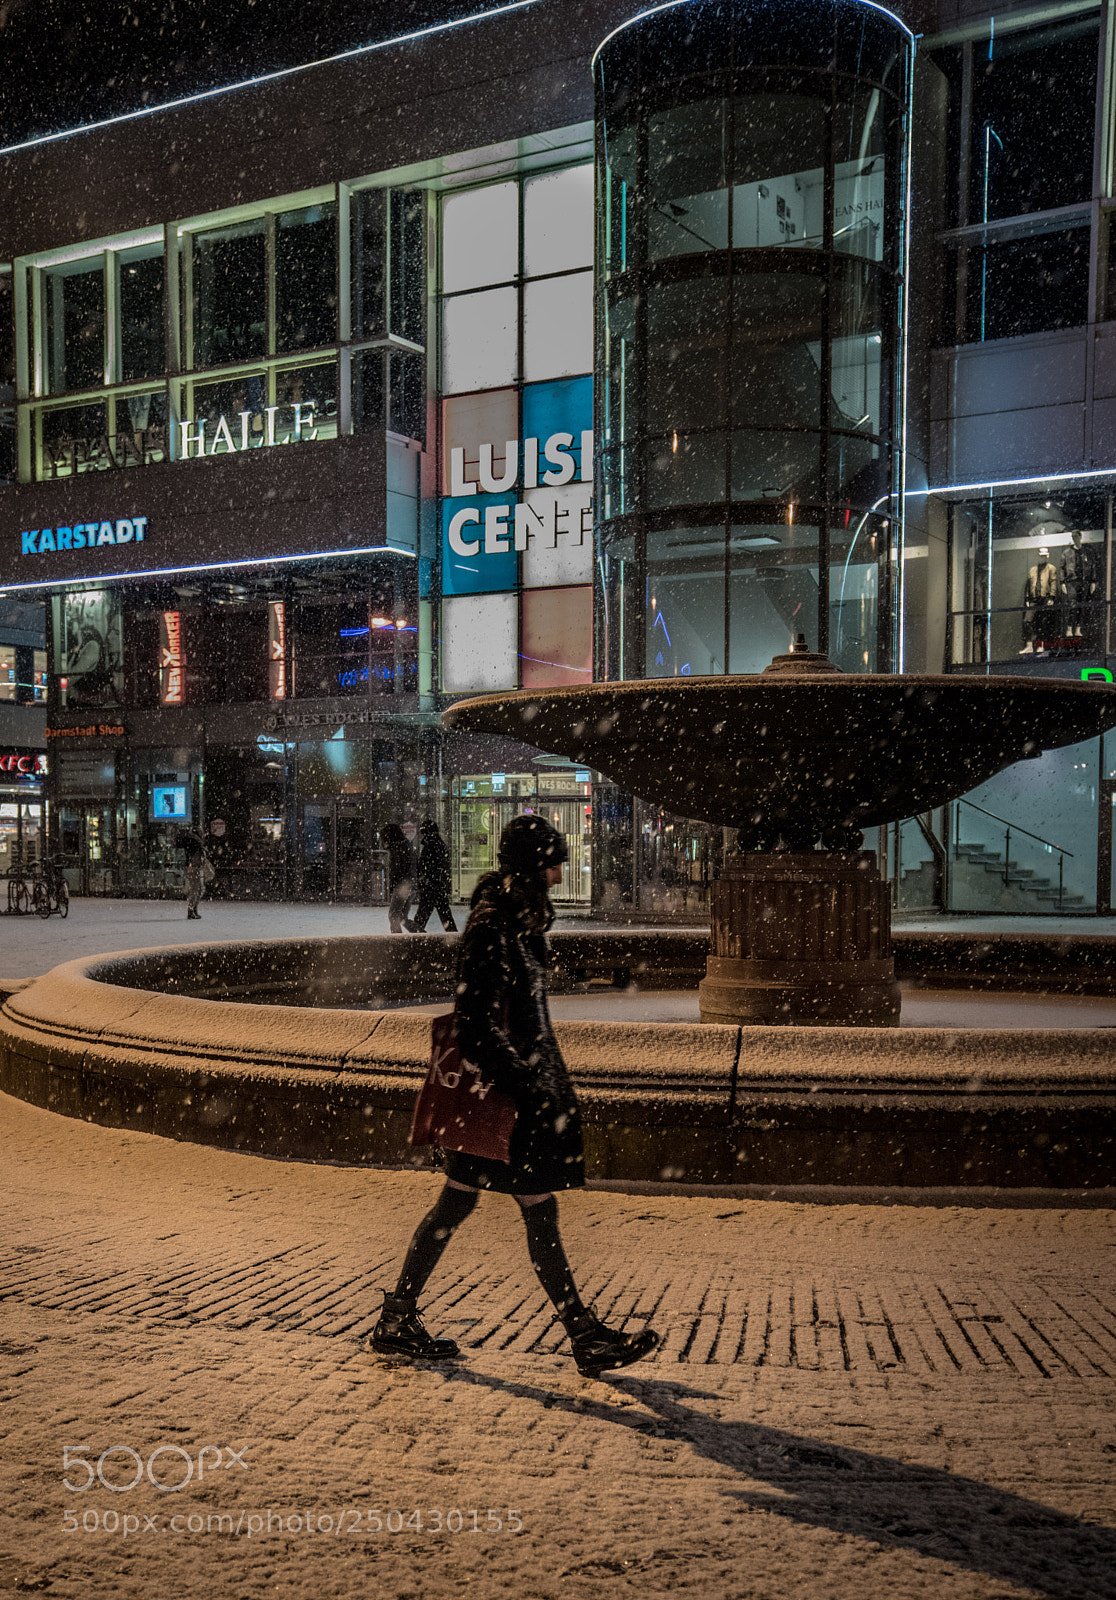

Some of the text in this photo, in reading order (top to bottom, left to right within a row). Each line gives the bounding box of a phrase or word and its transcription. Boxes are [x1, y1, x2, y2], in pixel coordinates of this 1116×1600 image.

[178, 401, 320, 460] HALLE
[21, 516, 148, 555] KARSTADT
[44, 724, 125, 738] Darmstadt Shop
[0, 755, 31, 773] KFC
